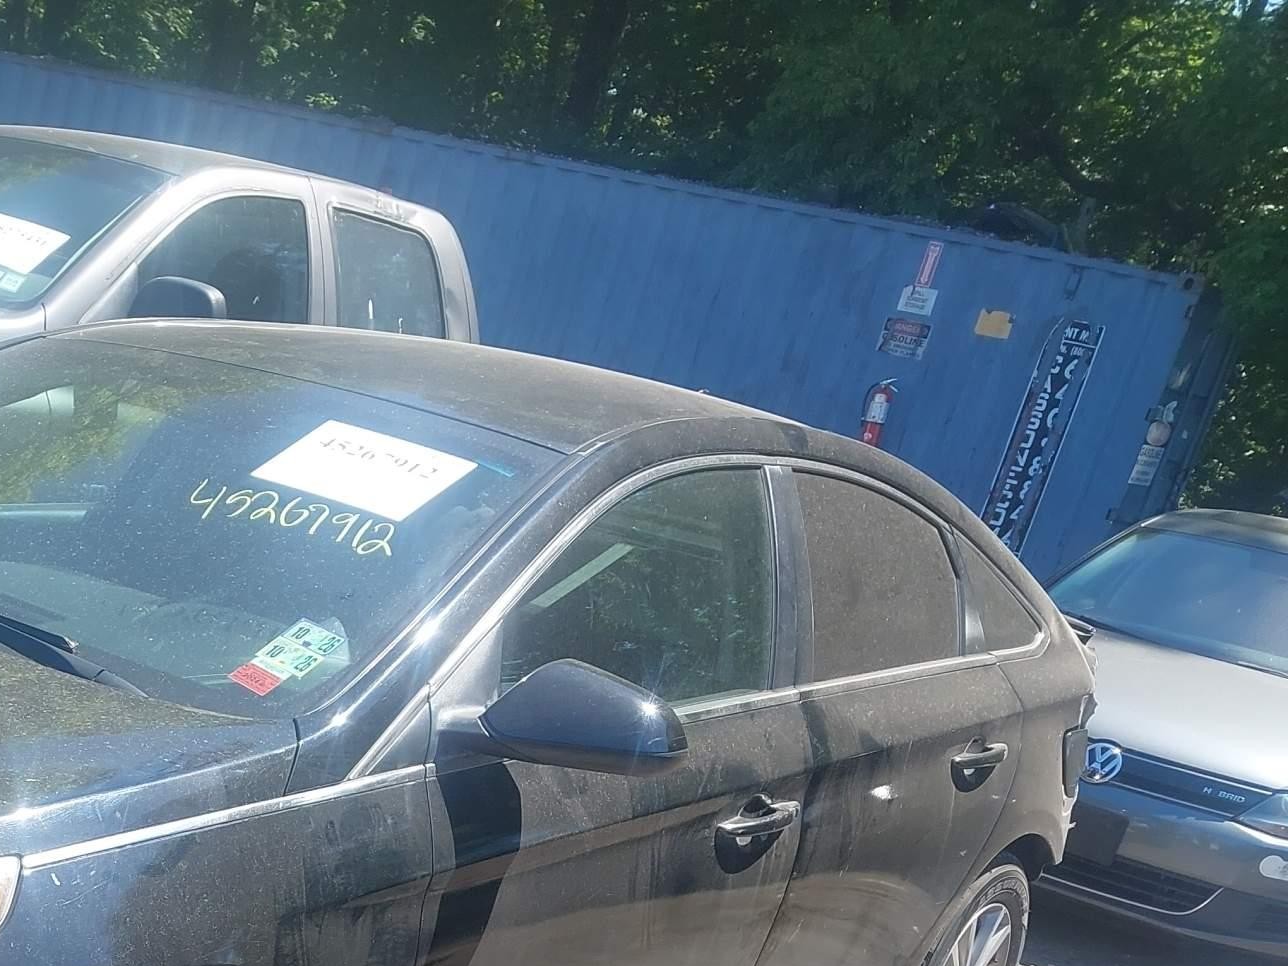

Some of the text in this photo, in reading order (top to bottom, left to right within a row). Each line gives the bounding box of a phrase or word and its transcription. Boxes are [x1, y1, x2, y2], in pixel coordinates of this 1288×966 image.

[190, 479, 393, 557] 45267912
[291, 626, 311, 640] 10
[265, 645, 286, 658] 10
[1202, 786, 1246, 803] HBRID
